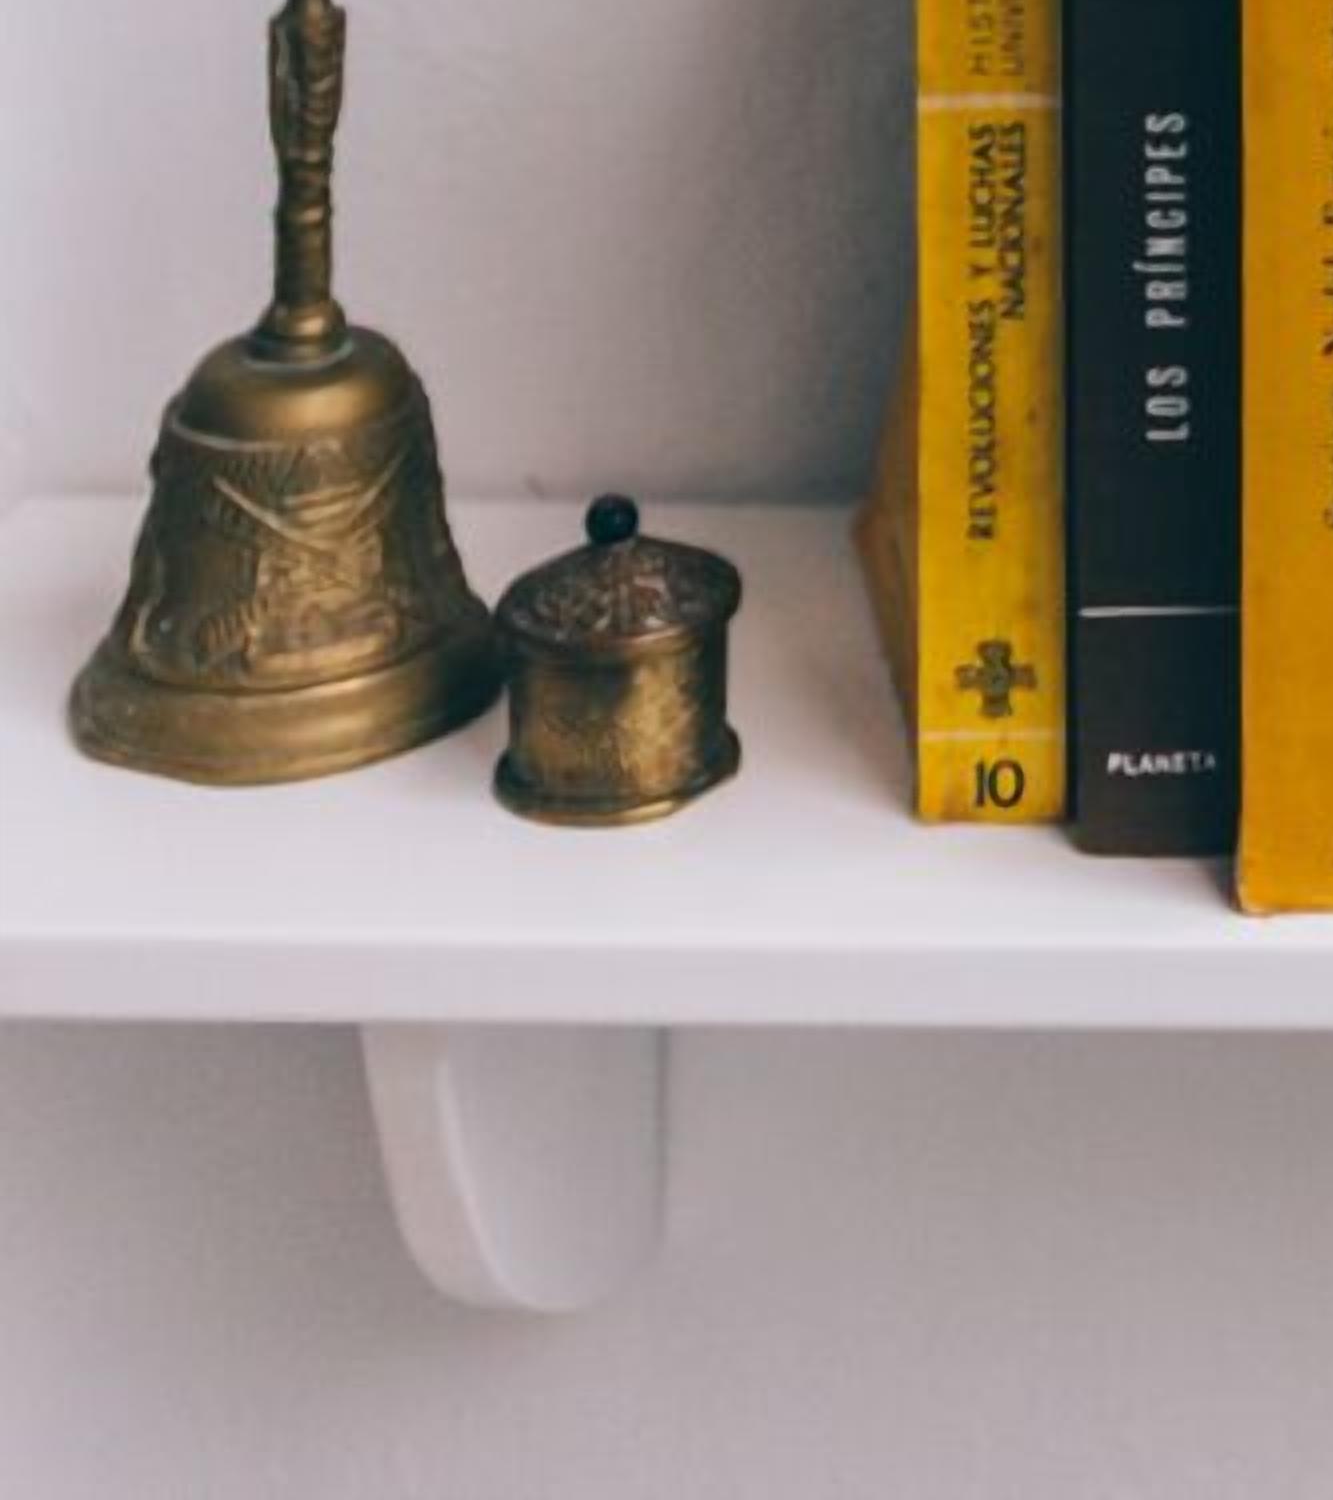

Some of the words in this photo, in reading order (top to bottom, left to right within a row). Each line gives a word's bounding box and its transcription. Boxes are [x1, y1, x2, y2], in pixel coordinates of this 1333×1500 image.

[969, 124, 998, 247] LUCHAS
[997, 123, 1026, 318] NACIONALES
[1132, 113, 1187, 327] PRÍNCIPES
[970, 264, 996, 278] Y
[968, 300, 998, 539] REVOLUCIONES
[1145, 366, 1189, 440] LOS
[975, 760, 1025, 808] 10
[1107, 752, 1214, 776] PLANETA
